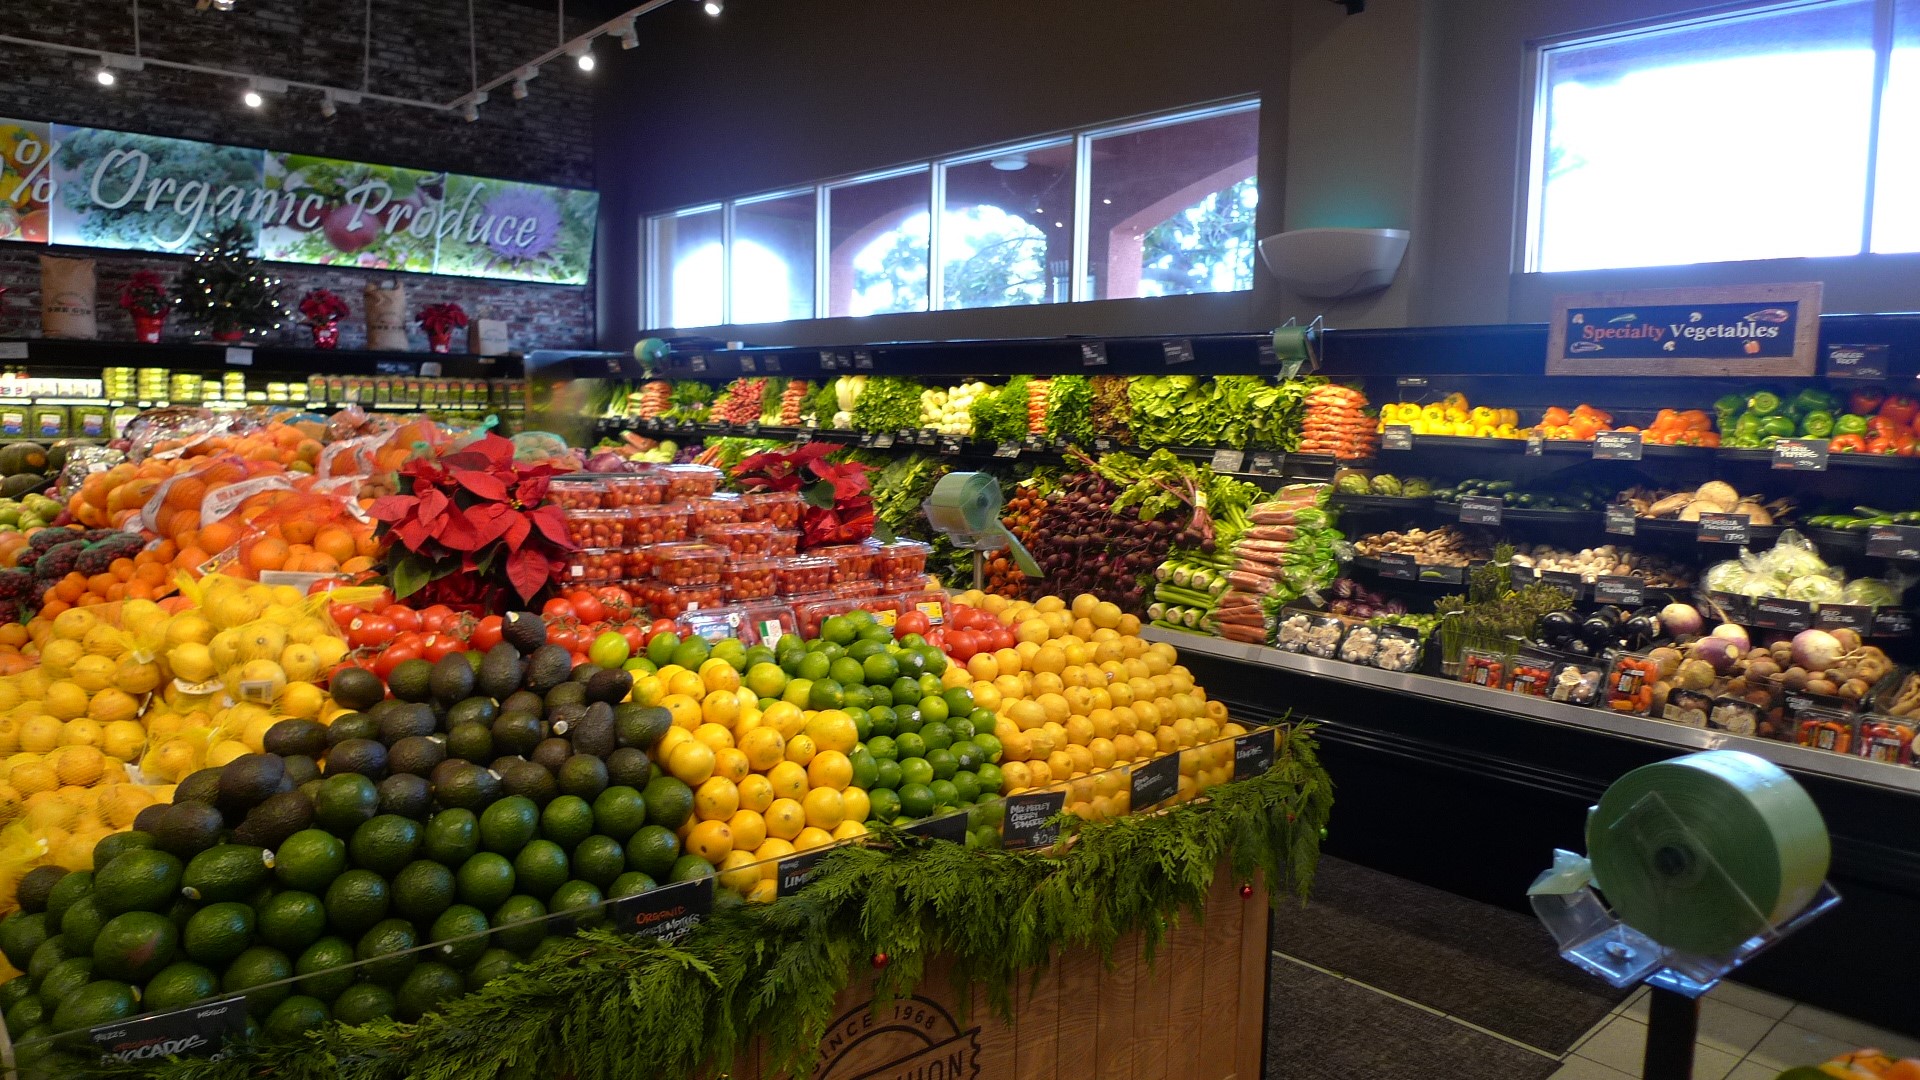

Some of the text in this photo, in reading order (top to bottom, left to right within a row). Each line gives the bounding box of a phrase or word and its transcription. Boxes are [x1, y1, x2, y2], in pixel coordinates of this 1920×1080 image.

[90, 147, 324, 250] Organic
[345, 180, 539, 248] Produce
[1583, 322, 1780, 342] Specialty Vegetables
[636, 905, 686, 925] ORGANIC
[894, 1006, 936, 1029] 1968
